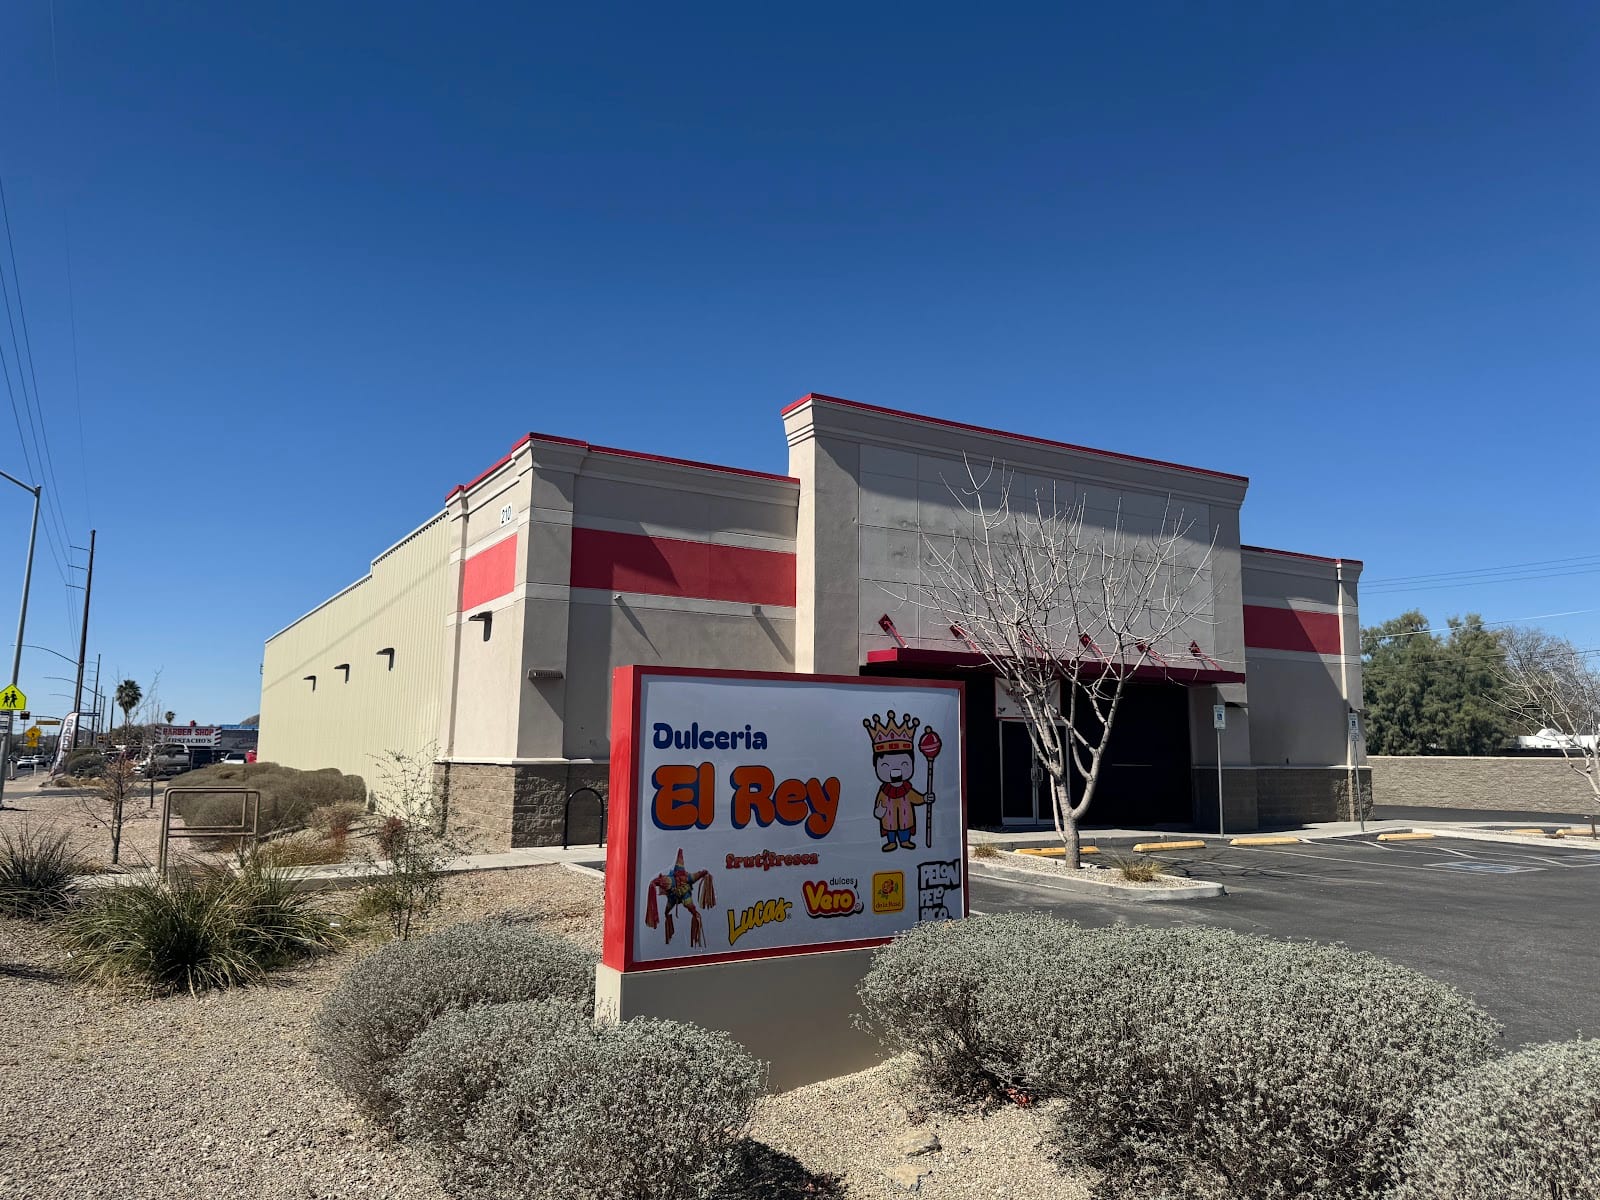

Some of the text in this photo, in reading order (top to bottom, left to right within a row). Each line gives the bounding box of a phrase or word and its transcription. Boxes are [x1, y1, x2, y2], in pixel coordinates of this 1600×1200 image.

[501, 505, 512, 524] 210
[163, 728, 214, 736] BARBER SHOP
[653, 722, 767, 750] Dulceria
[651, 761, 841, 839] El Rey
[829, 877, 854, 886] dulces
[920, 860, 960, 889] PELON
[804, 882, 854, 913] Vero
[919, 886, 944, 907] PELO
[727, 897, 792, 946] Lucas
